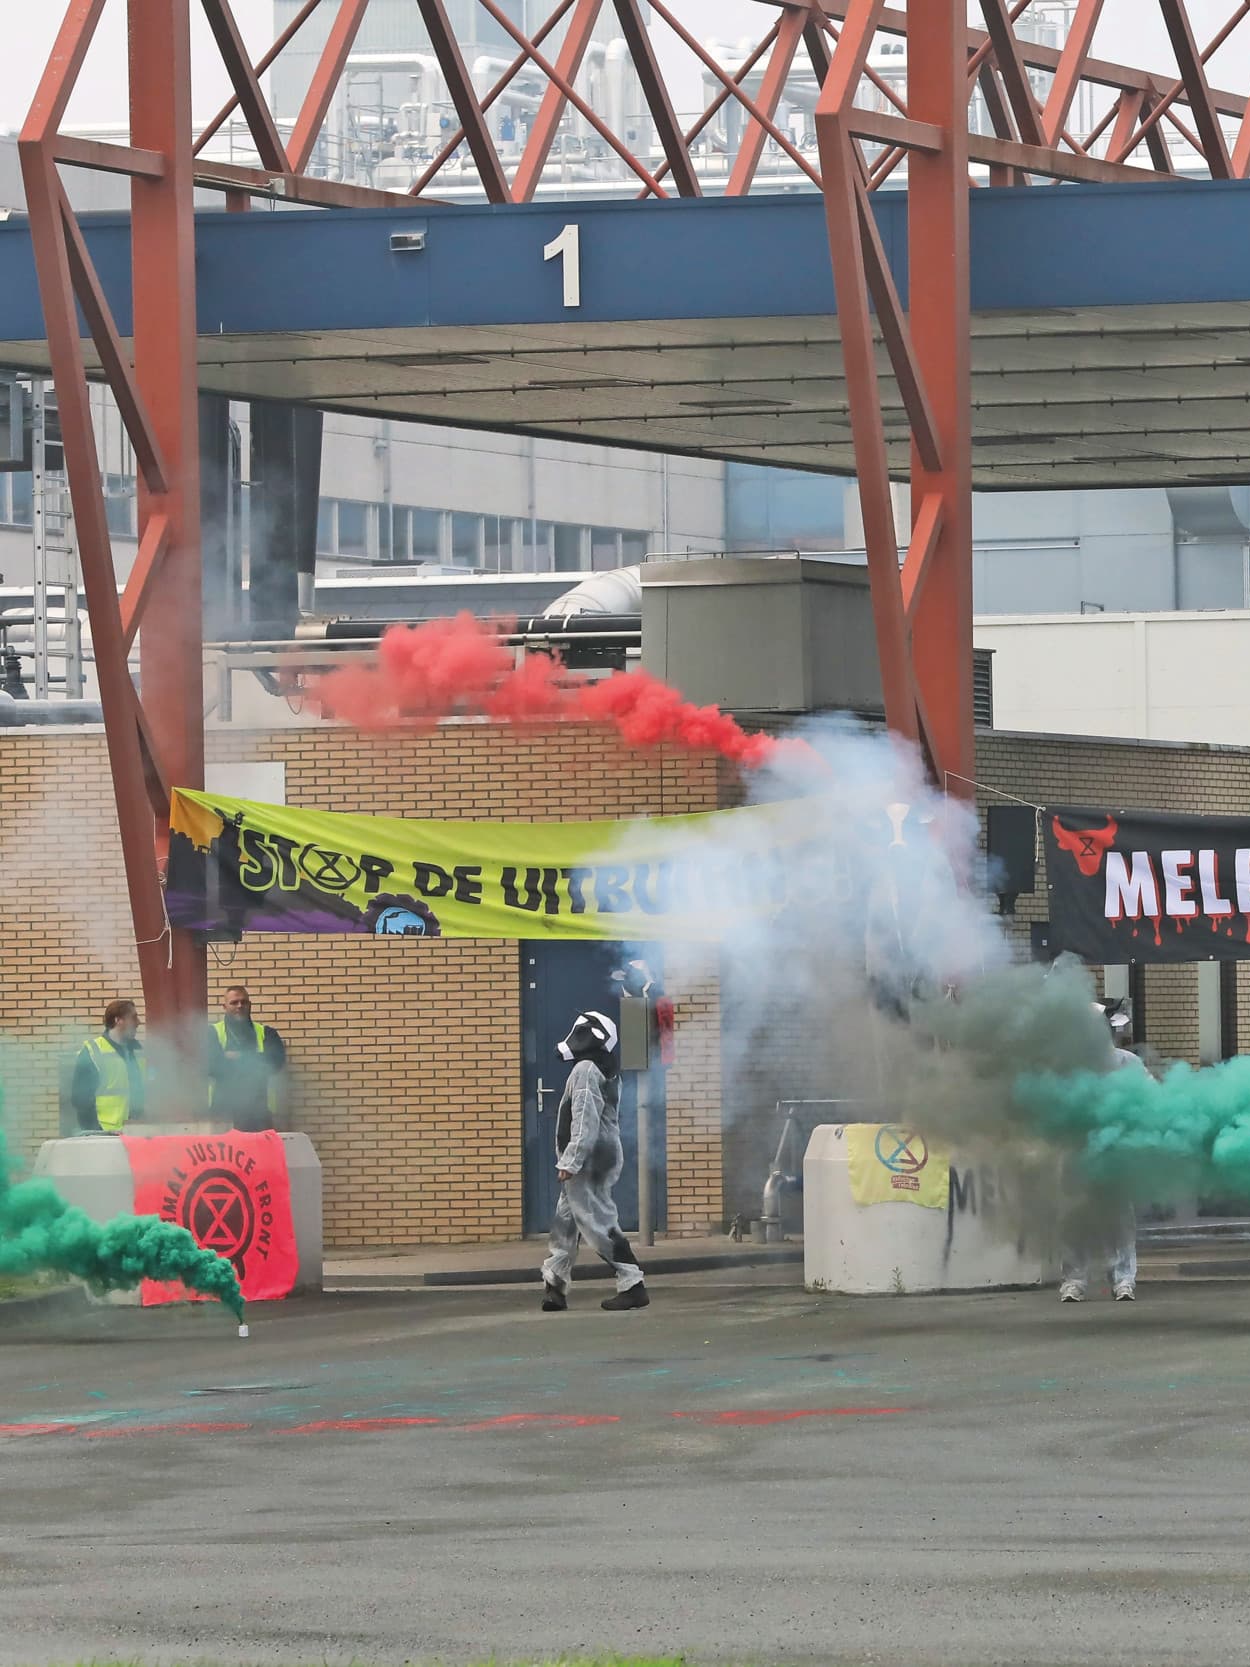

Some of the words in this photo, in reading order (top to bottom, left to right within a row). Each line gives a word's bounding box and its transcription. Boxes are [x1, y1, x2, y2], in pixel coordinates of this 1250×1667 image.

[543, 224, 580, 307] 1
[413, 861, 482, 904] DE
[186, 1142, 256, 1176] JUSTICE
[256, 1180, 273, 1261] FRONT
